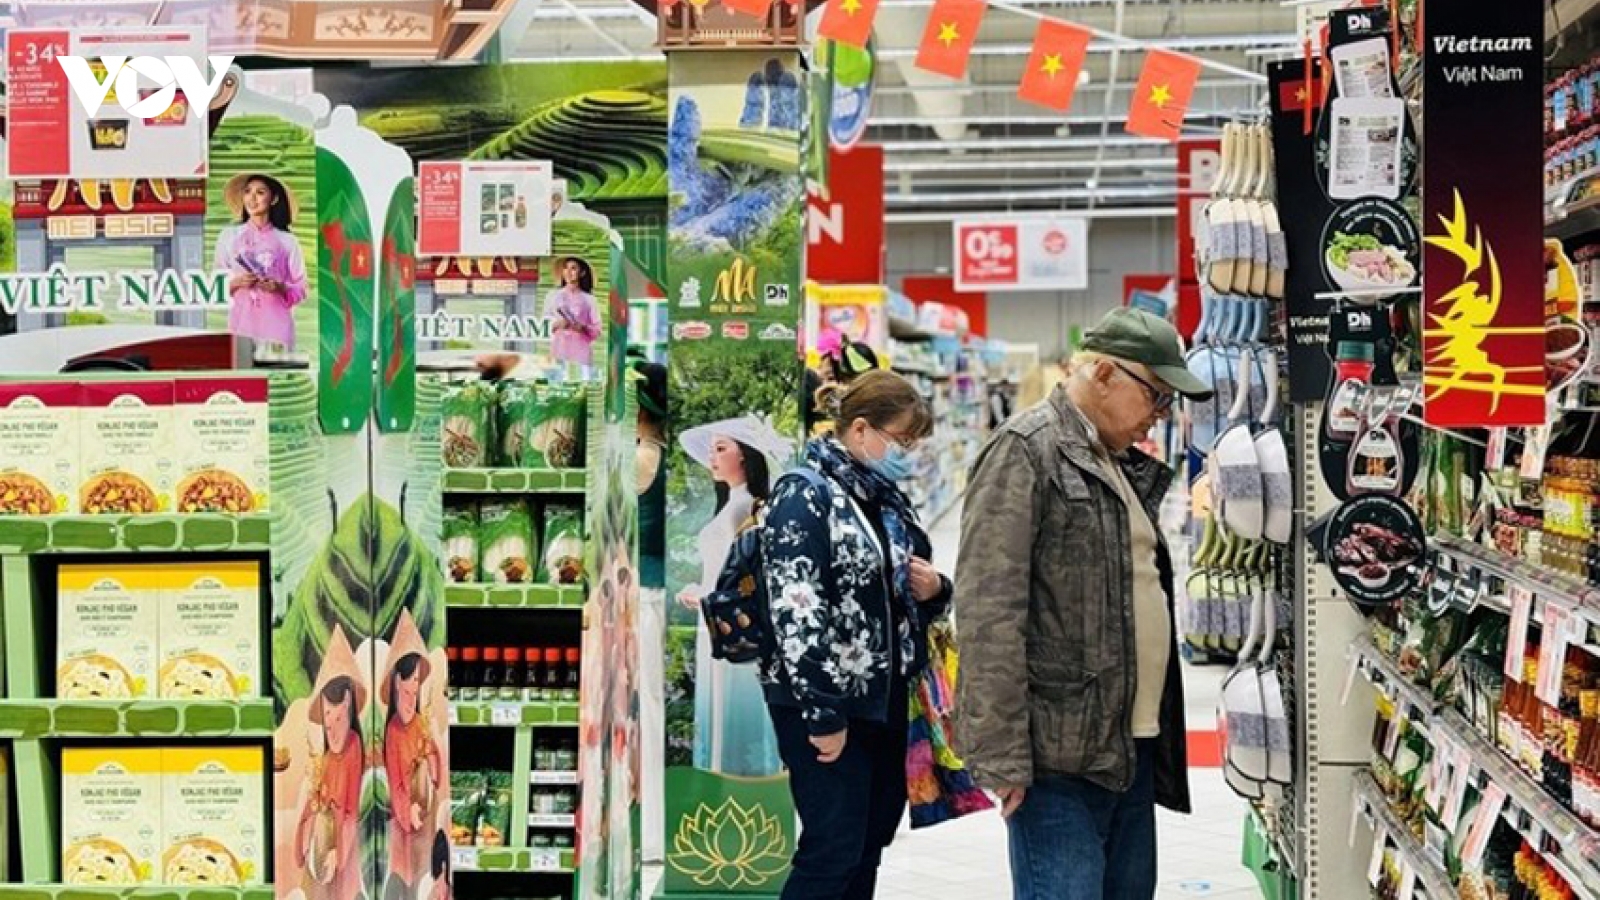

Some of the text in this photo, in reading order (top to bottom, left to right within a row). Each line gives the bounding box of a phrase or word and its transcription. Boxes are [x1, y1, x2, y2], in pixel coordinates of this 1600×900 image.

[1433, 35, 1532, 54] Vietnam
[1442, 65, 1523, 87] Việt Nam
[0, 266, 227, 307] VIÊT NAM
[419, 313, 550, 338] IÊT NAM
